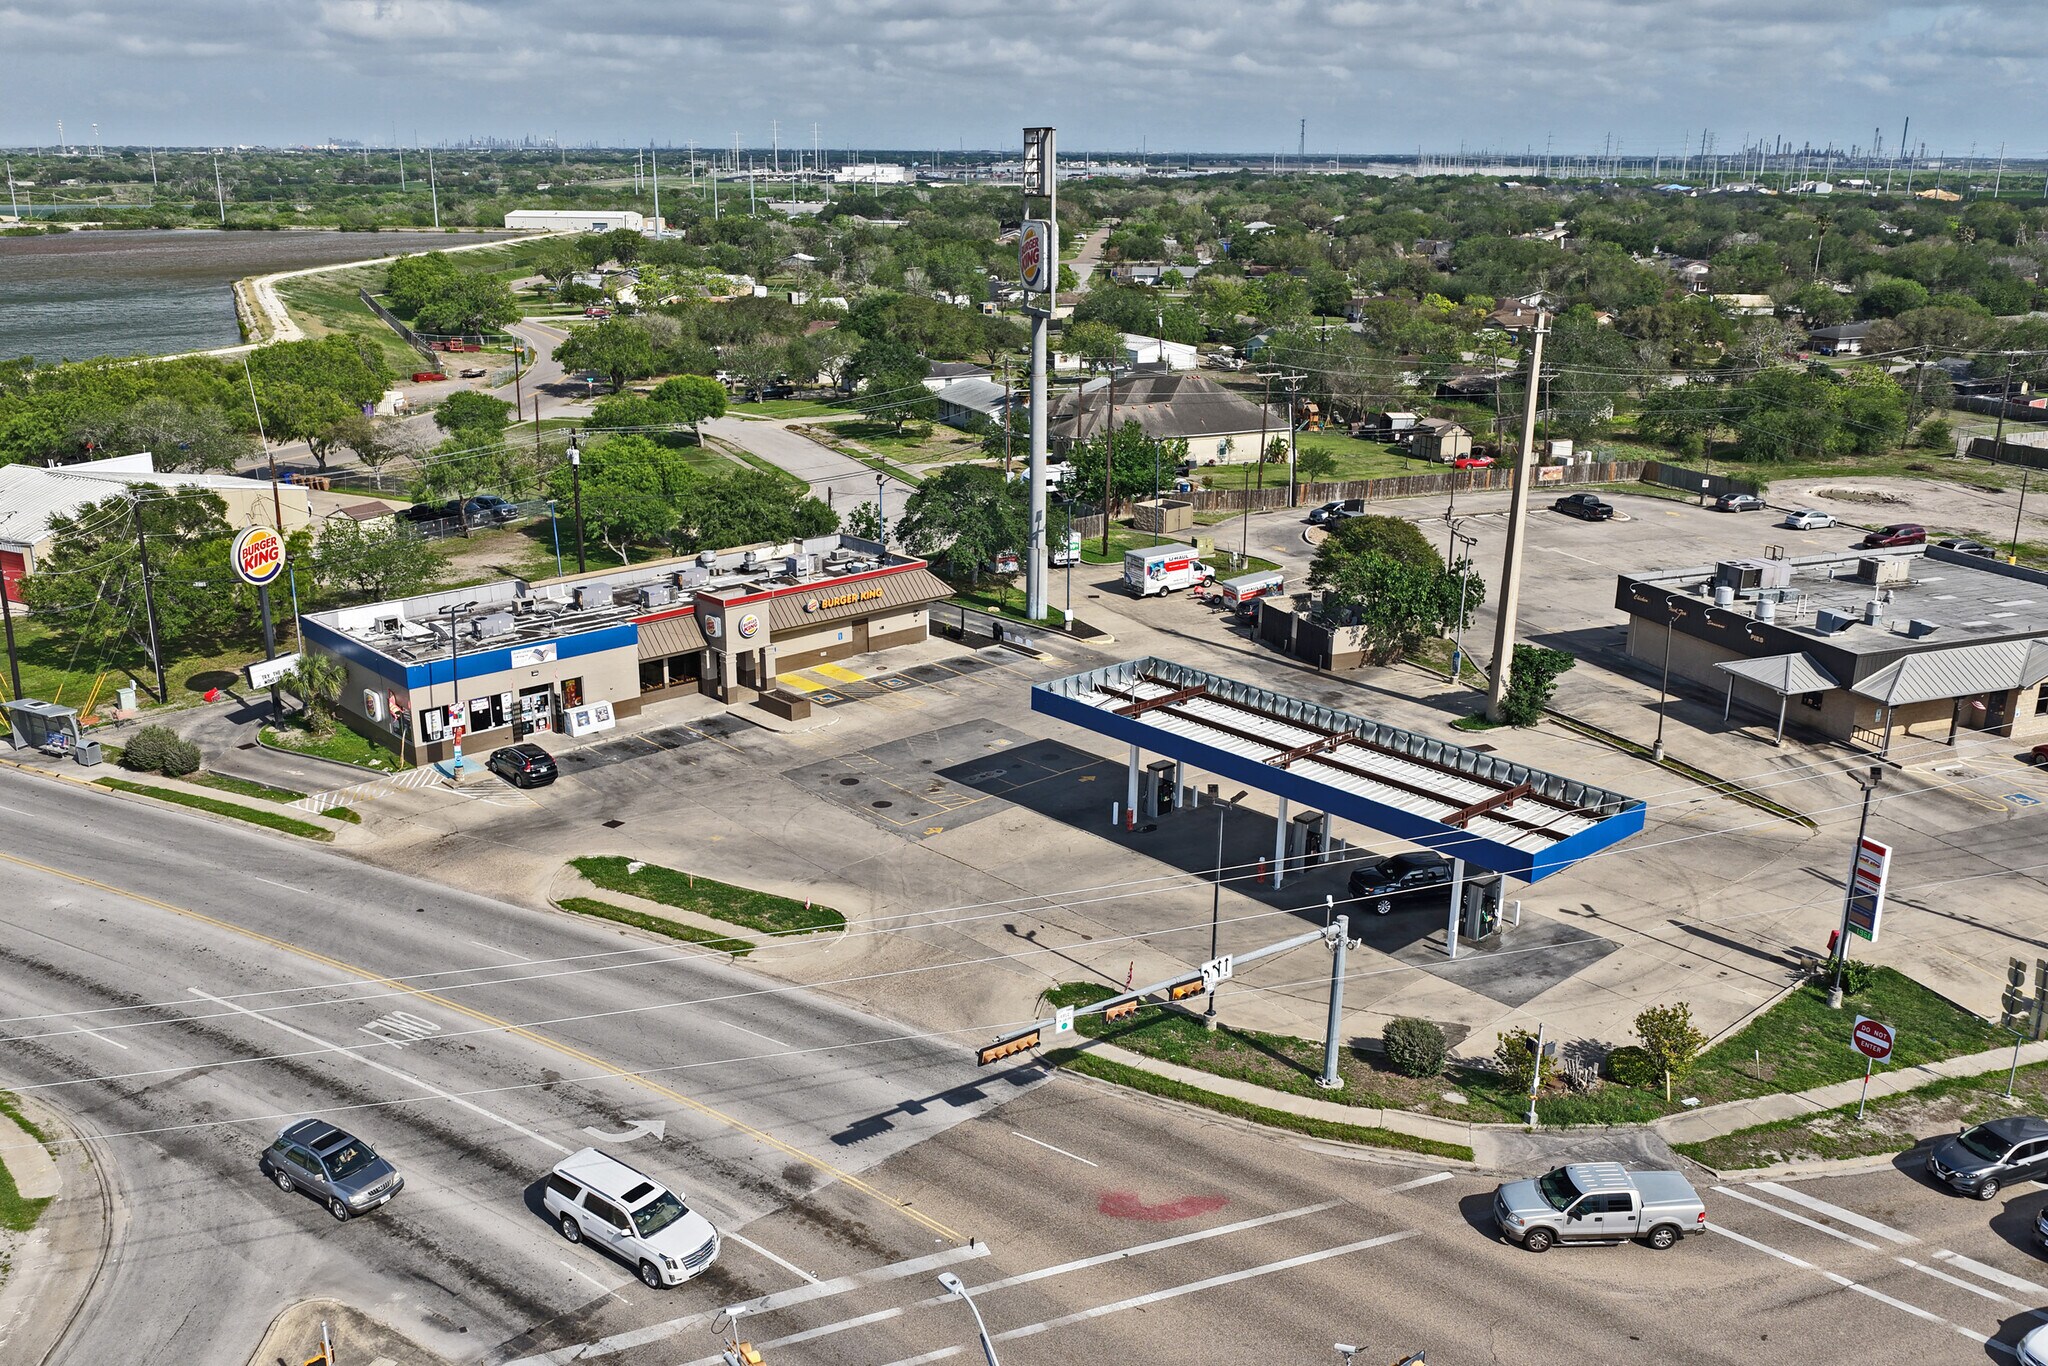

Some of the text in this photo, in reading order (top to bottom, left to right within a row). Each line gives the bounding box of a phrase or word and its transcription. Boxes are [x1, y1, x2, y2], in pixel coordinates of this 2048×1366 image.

[242, 536, 277, 559] BURGER
[244, 546, 279, 573] KING
[822, 593, 859, 609] BURGER
[860, 587, 883, 601] KING
[357, 1010, 442, 1050] ONLY
[1861, 1025, 1887, 1040] DO NOT
[1860, 1040, 1882, 1053] ENTER
